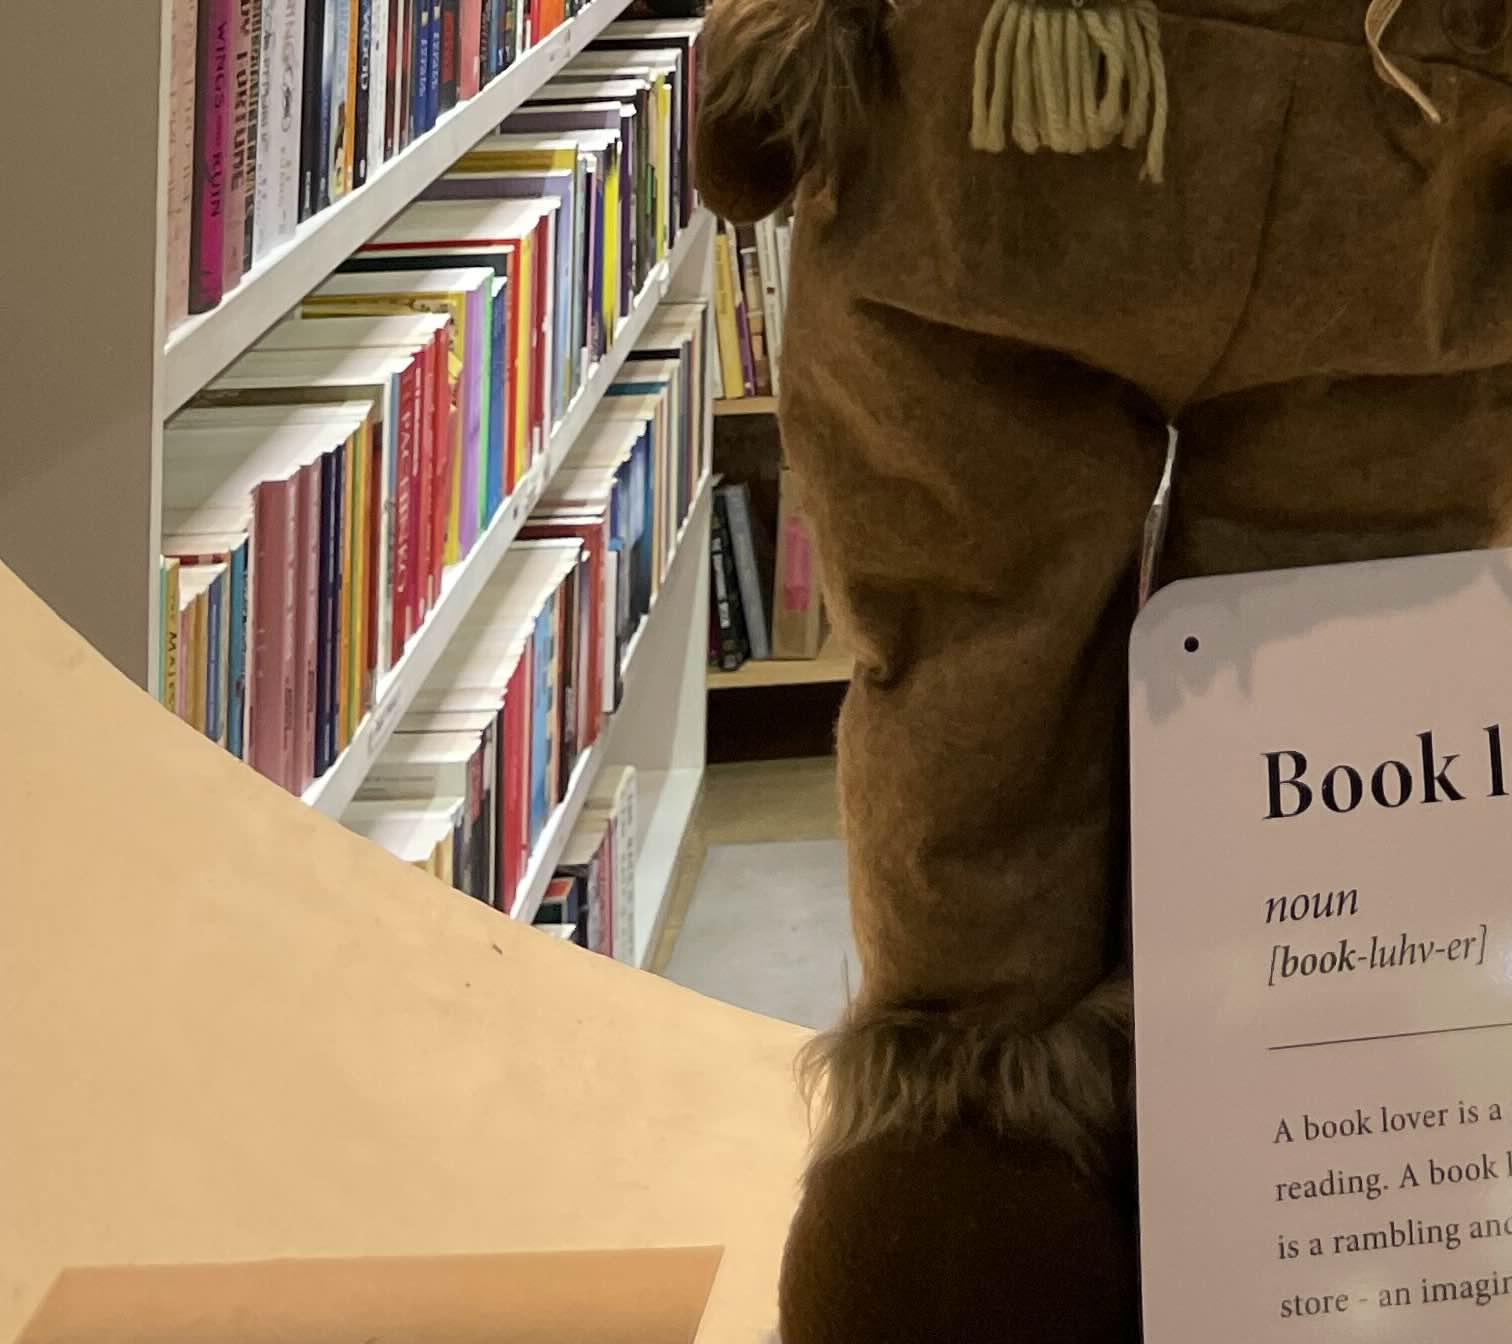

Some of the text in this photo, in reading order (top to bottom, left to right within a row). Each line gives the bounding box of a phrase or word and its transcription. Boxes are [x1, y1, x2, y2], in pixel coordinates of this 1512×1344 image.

[214, 22, 228, 109] WINGS
[230, 51, 248, 192] FORTUNE
[209, 153, 224, 218] RUIN
[394, 409, 411, 592] PACHINKO
[1261, 728, 1467, 821] Book
[1264, 886, 1360, 924] noun
[1267, 922, 1489, 988] [book-luhv-er]
[1273, 1116, 1294, 1145] A
[1303, 1105, 1373, 1143] book
[1380, 1100, 1449, 1135] lover
[1458, 1097, 1480, 1127] is
[1487, 1102, 1503, 1123] a
[1274, 1163, 1390, 1212] reading.
[1399, 1163, 1422, 1190] A
[1428, 1150, 1499, 1188] book
[1276, 1230, 1301, 1261] is
[1308, 1235, 1325, 1258] a
[1331, 1215, 1461, 1268] rambling
[1279, 1287, 1350, 1320] store
[1377, 1282, 1413, 1309] an
